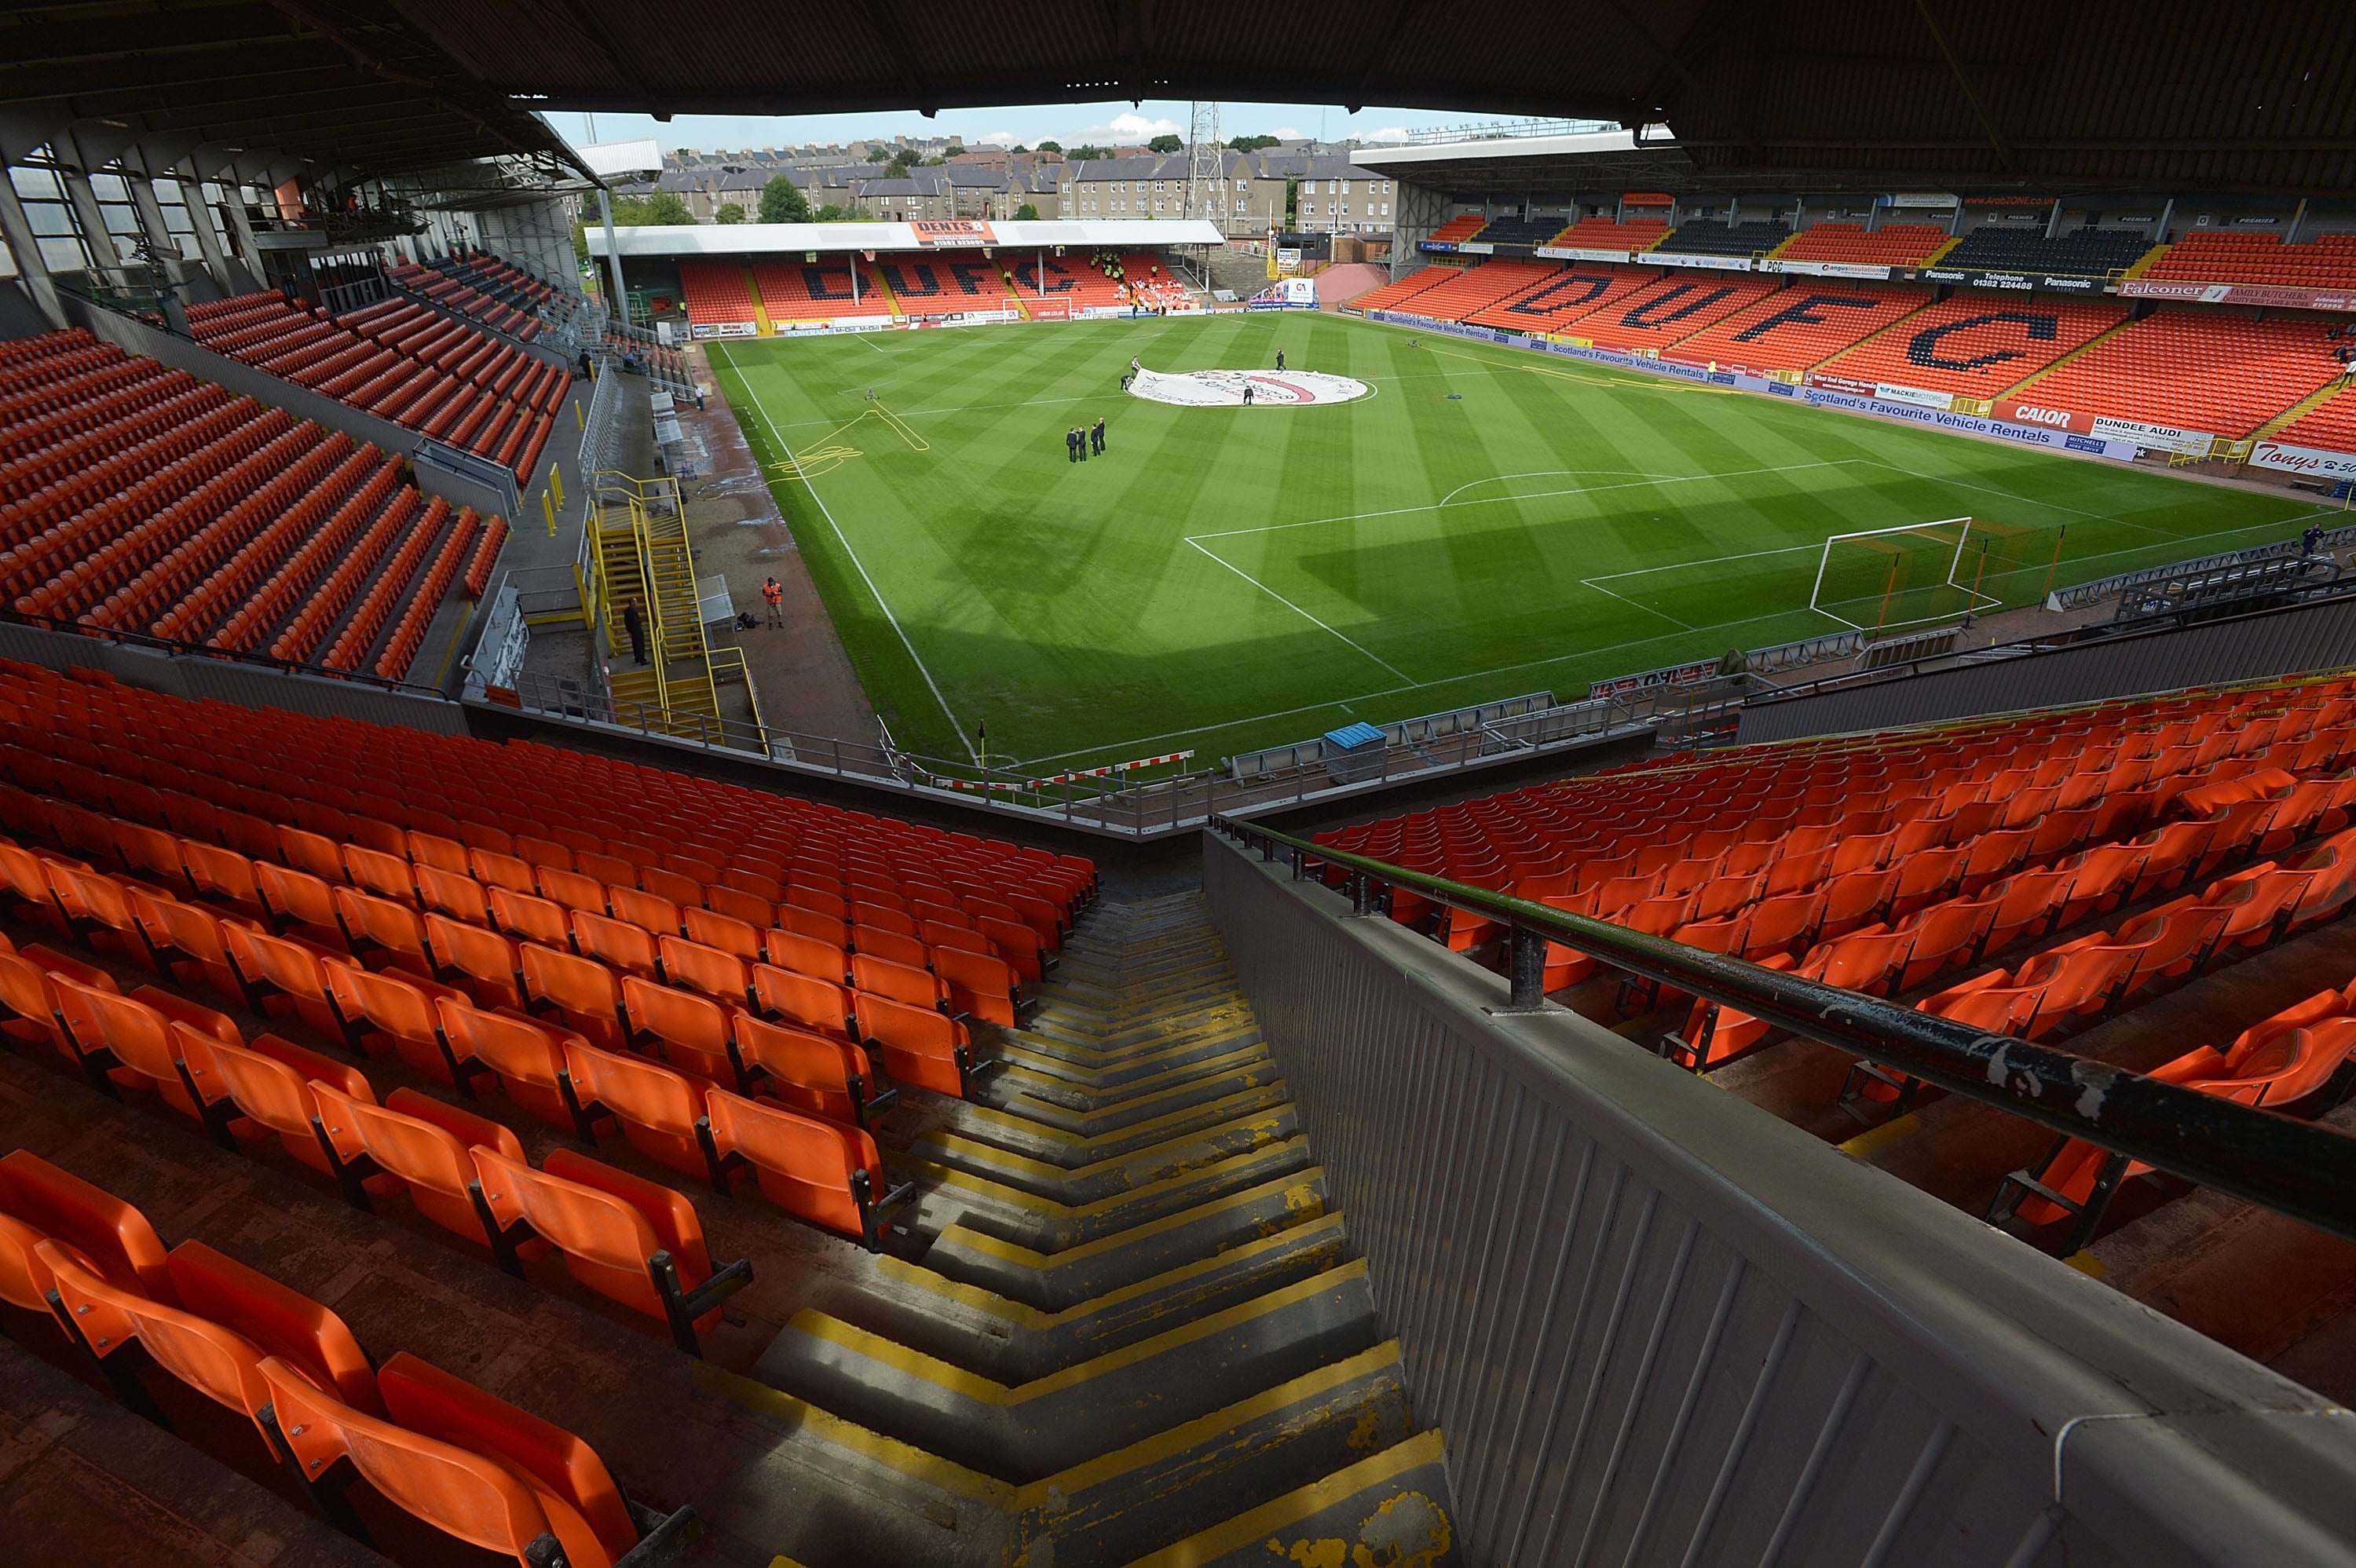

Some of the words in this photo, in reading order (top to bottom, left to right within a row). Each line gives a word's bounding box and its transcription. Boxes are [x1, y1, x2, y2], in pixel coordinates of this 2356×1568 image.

[1767, 261, 1783, 272] PCC
[1925, 270, 1965, 280] Panasonic
[1985, 272, 2024, 282] Telephone
[1973, 279, 1998, 287] 01382
[1999, 281, 2032, 290] 224488
[2044, 277, 2091, 288] Panasonic
[2123, 283, 2204, 295] Falconer
[2230, 288, 2261, 298] FAMILY
[2261, 291, 2309, 300] BUTCHERS
[1389, 315, 1416, 325] Scotland's
[1417, 320, 1443, 331] Favourite
[1443, 325, 1465, 334] Vehicle
[1465, 328, 1489, 339] Rentals
[1553, 344, 1593, 358] Scotland's
[1595, 352, 1633, 365] Favourite
[1636, 359, 1666, 372] Vehicle
[1669, 364, 1704, 378] Rentals
[1838, 378, 1857, 387] Garage
[1858, 381, 1877, 389] Honda
[1804, 389, 1867, 409] Scotland's
[1869, 401, 1931, 421] Favourite
[1935, 412, 1987, 432] Vehicle
[1991, 424, 2051, 443] Rentals
[2015, 406, 2071, 428] CALOR
[2095, 418, 2147, 432] DUNDEE
[2149, 426, 2182, 437] AUDI
[2068, 436, 2105, 448] MITCHELLS
[2135, 448, 2146, 457] nk
[2258, 444, 2319, 471] Tonys
